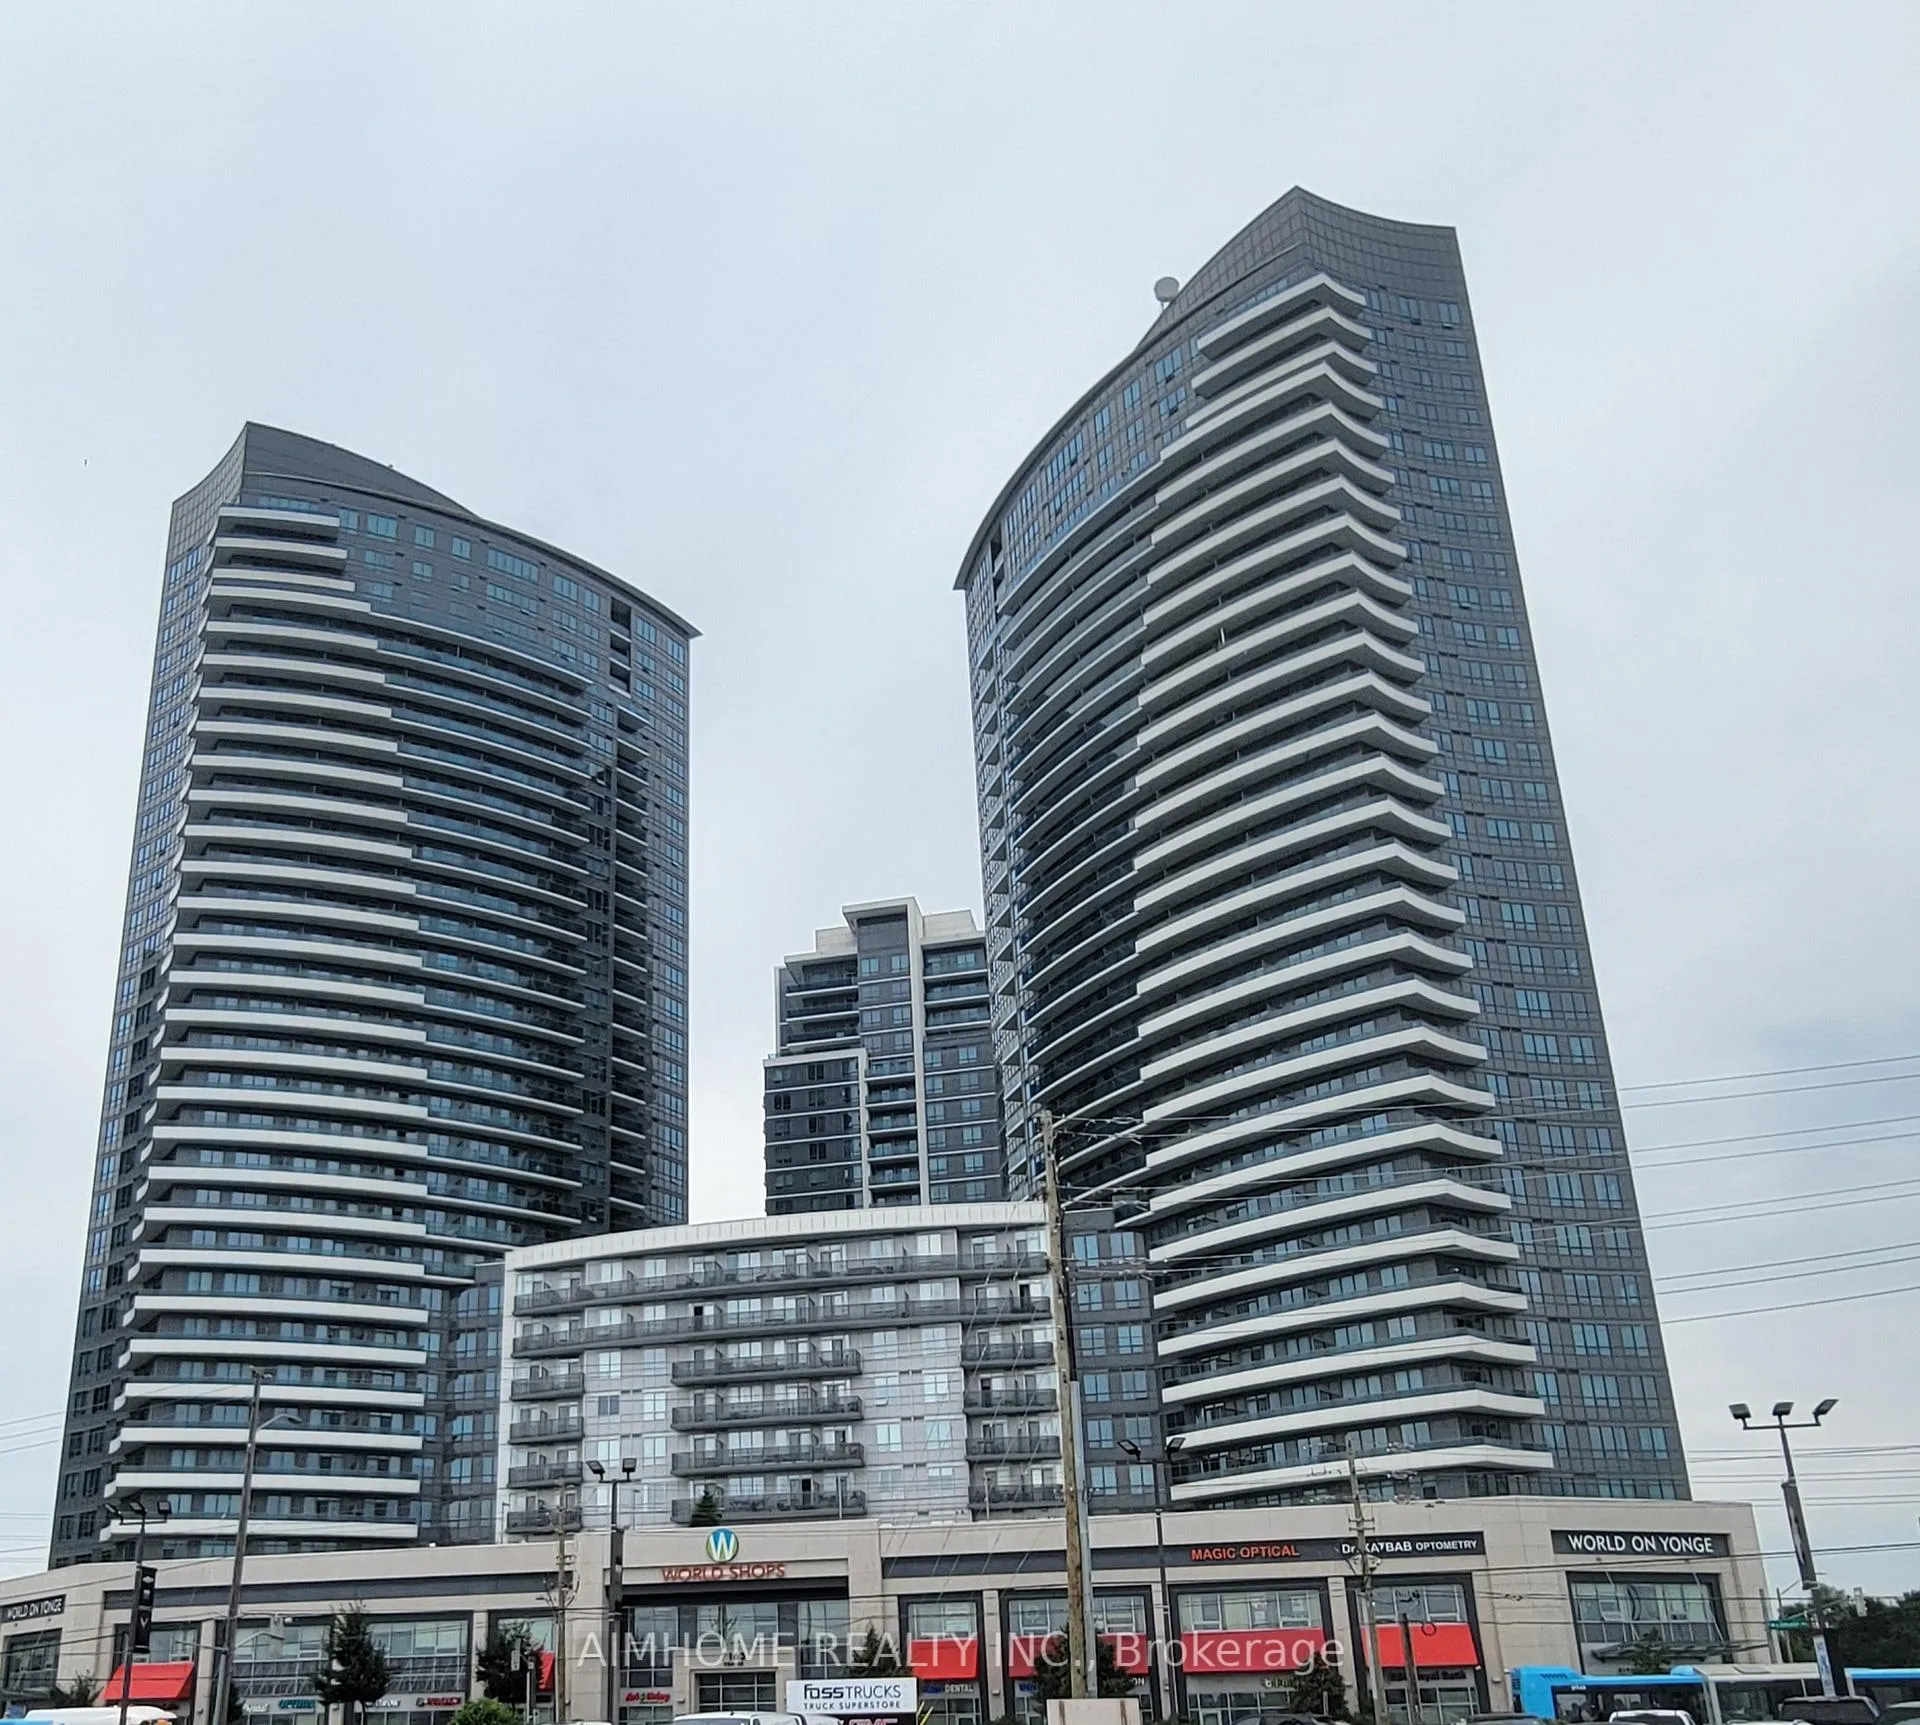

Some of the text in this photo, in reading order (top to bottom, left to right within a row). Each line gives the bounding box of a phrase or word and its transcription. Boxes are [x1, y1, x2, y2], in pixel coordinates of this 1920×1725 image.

[708, 1531, 736, 1562] W
[1415, 1540, 1478, 1551] OPTOMETRY
[1567, 1534, 1714, 1553] WORLD ON YONGE
[1190, 1544, 1301, 1561] MAGIC OPTICAL
[662, 1563, 786, 1581] WORLD SHOPS
[804, 1700, 901, 1711] TRUCK SUPERSTORE
